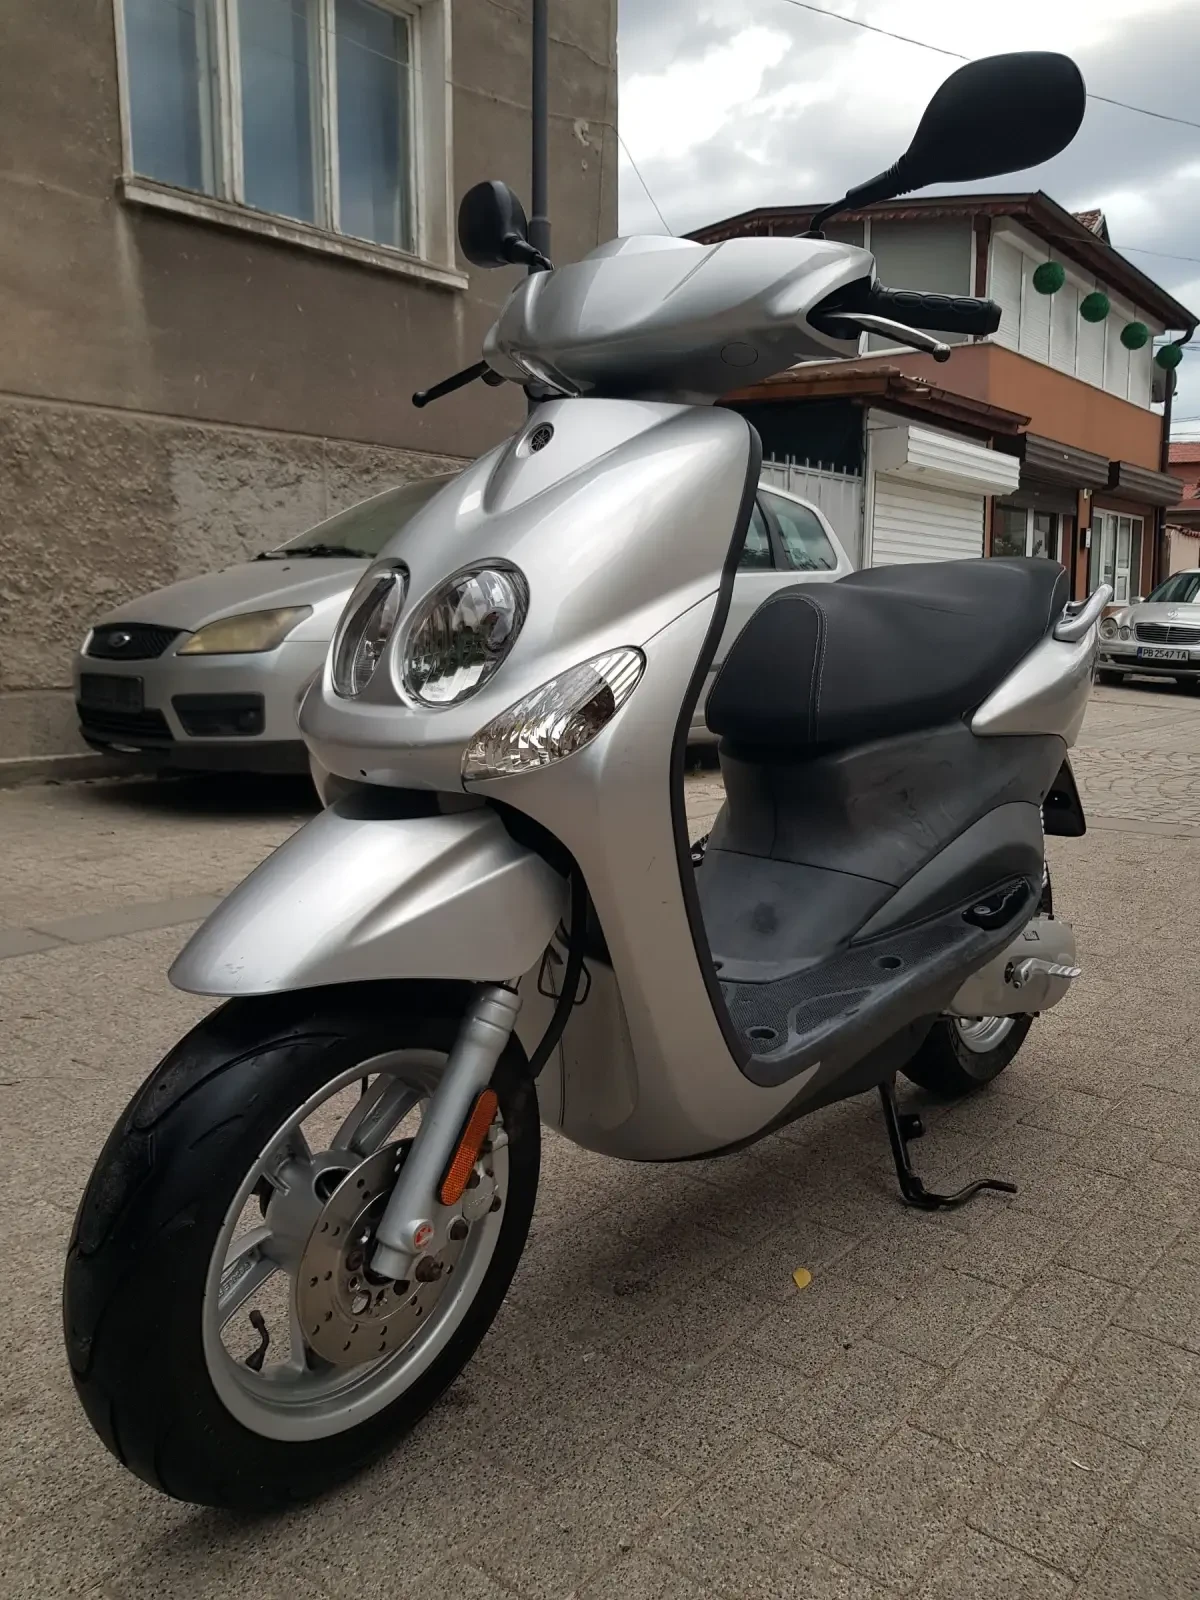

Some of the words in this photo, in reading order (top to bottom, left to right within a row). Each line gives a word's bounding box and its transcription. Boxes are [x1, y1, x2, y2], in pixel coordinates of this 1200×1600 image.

[1143, 649, 1153, 657] PB
[1155, 650, 1174, 658] 2547
[1176, 651, 1186, 659] TA
